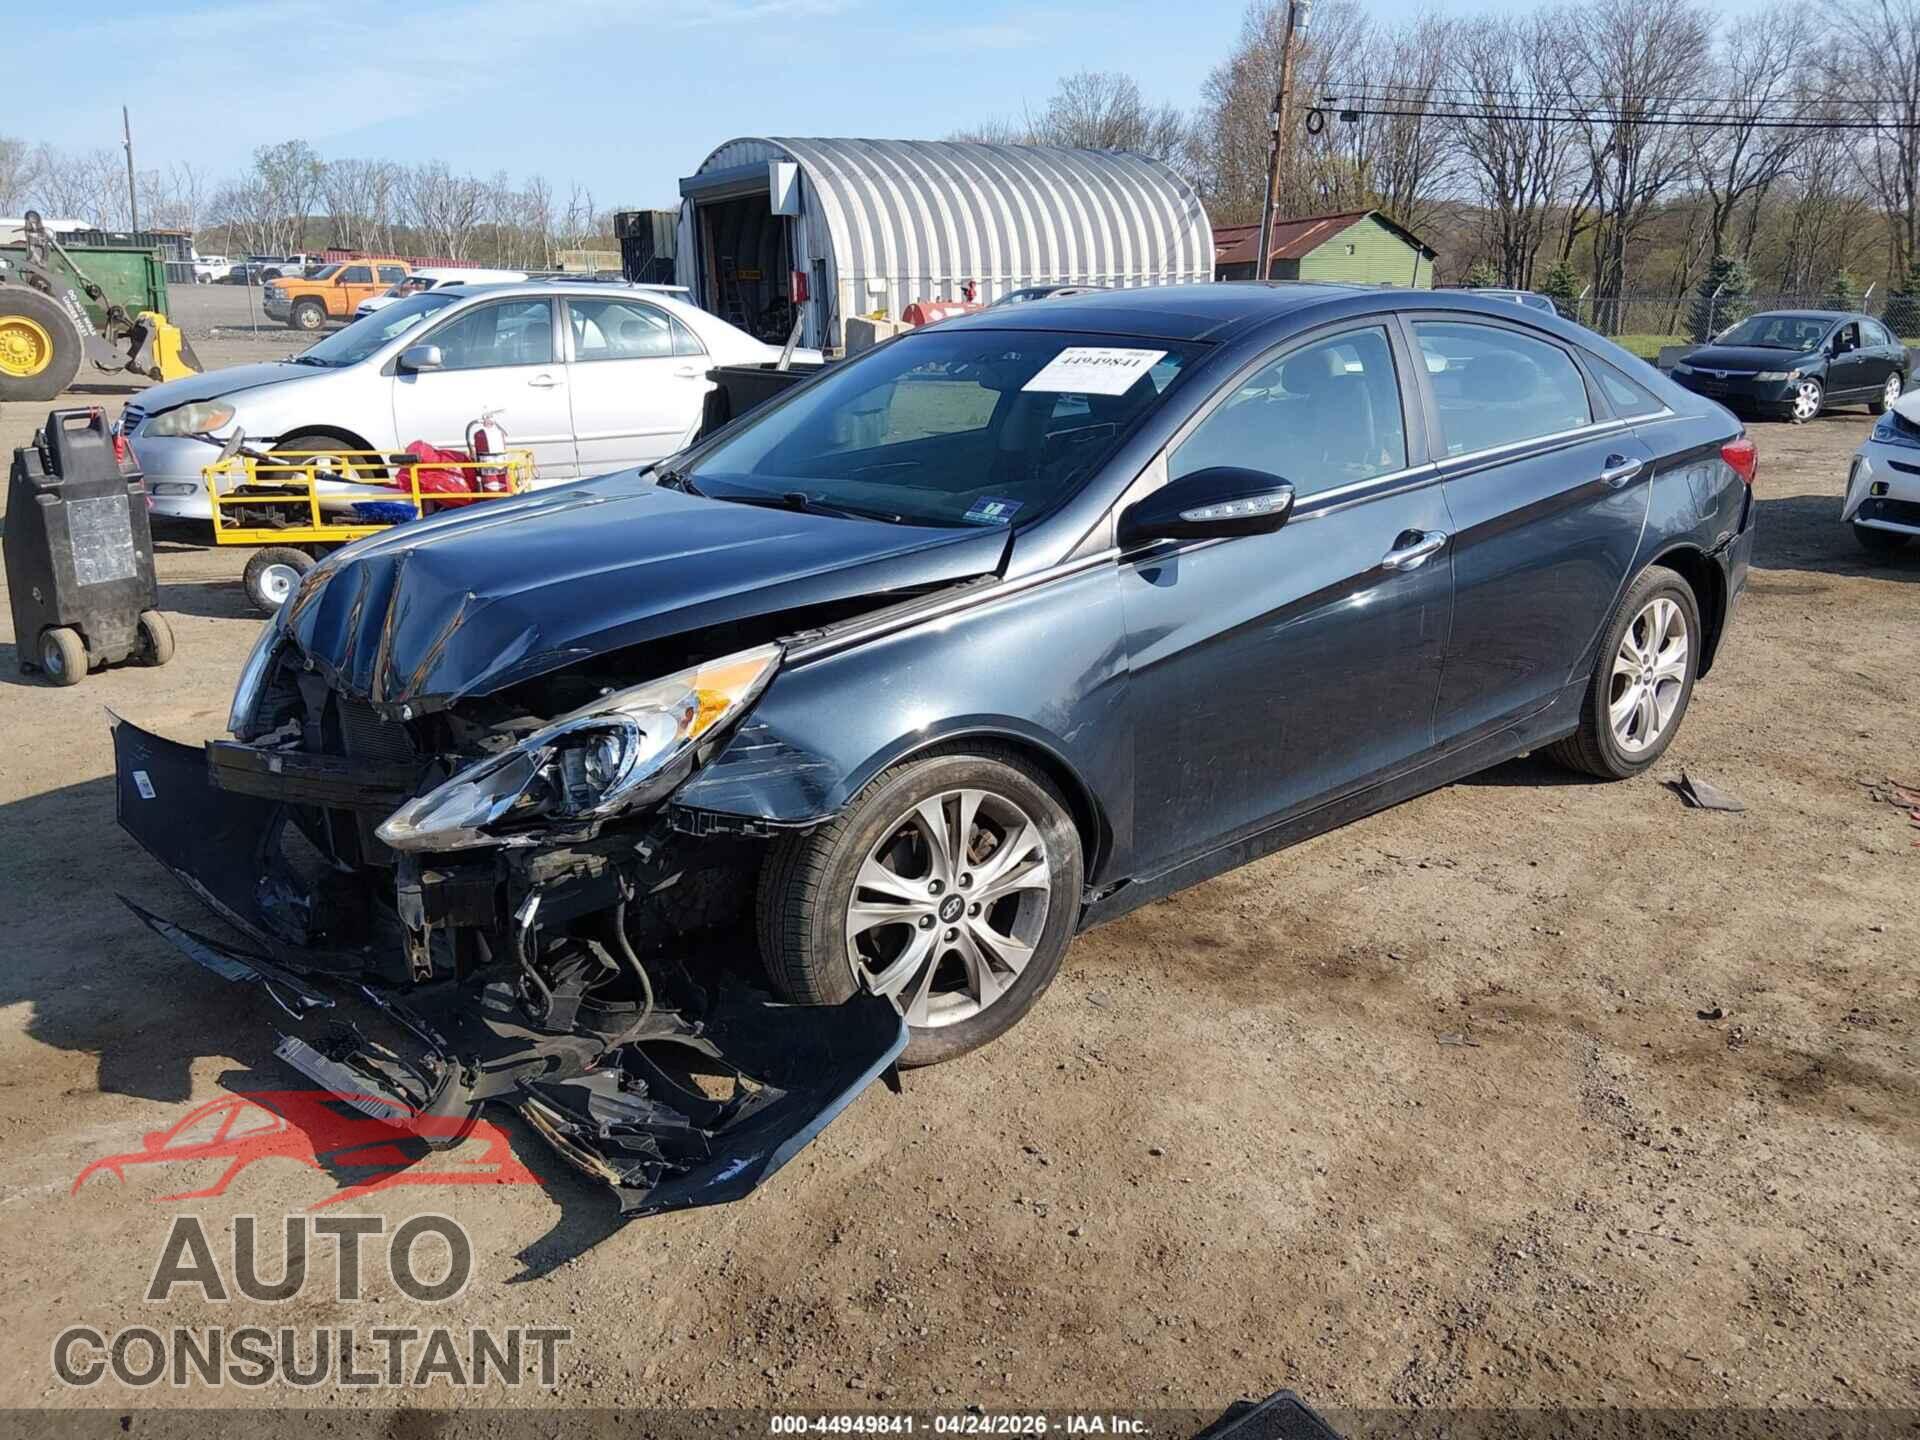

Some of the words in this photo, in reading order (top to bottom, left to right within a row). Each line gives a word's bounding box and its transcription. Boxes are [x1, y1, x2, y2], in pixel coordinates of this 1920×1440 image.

[67, 289, 77, 301] DO
[73, 301, 87, 315] NOT
[83, 316, 97, 337] WALK
